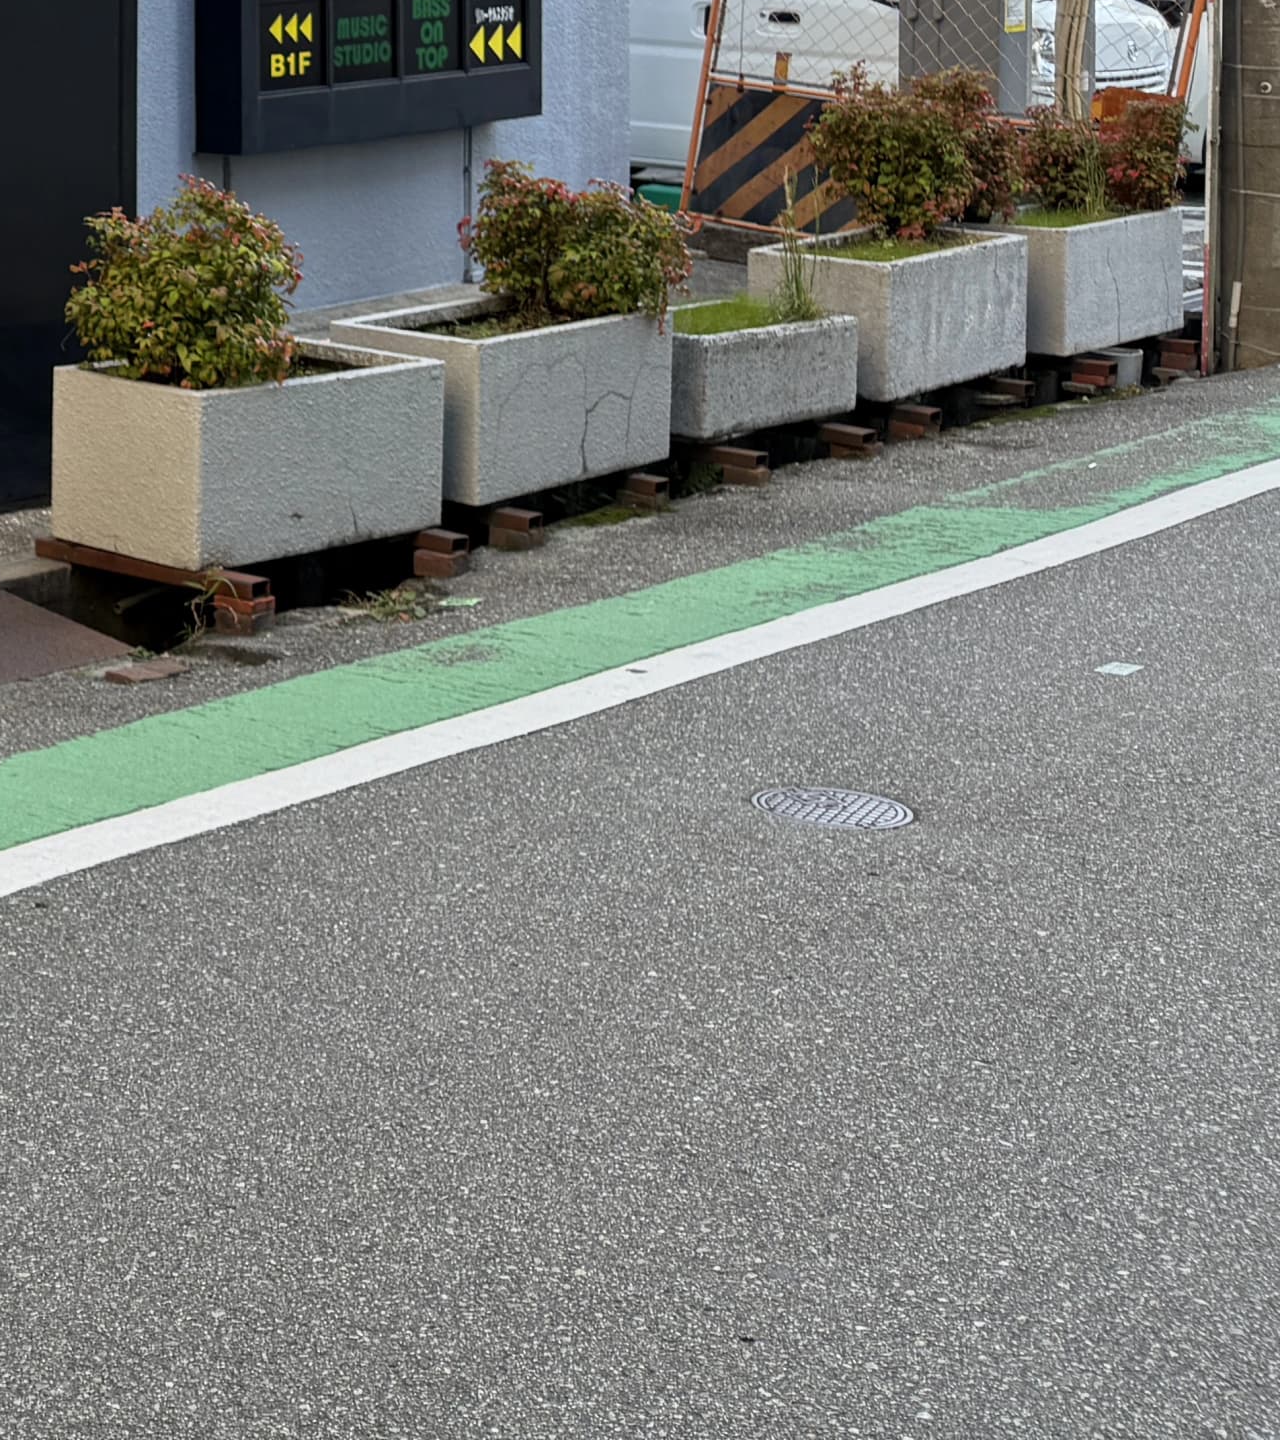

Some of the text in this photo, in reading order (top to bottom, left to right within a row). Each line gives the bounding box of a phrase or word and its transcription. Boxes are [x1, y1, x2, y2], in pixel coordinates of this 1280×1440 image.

[336, 14, 388, 40] MUSIC
[270, 50, 313, 78] B1F
[333, 41, 391, 67] STUDIO
[416, 45, 449, 71] TOP
